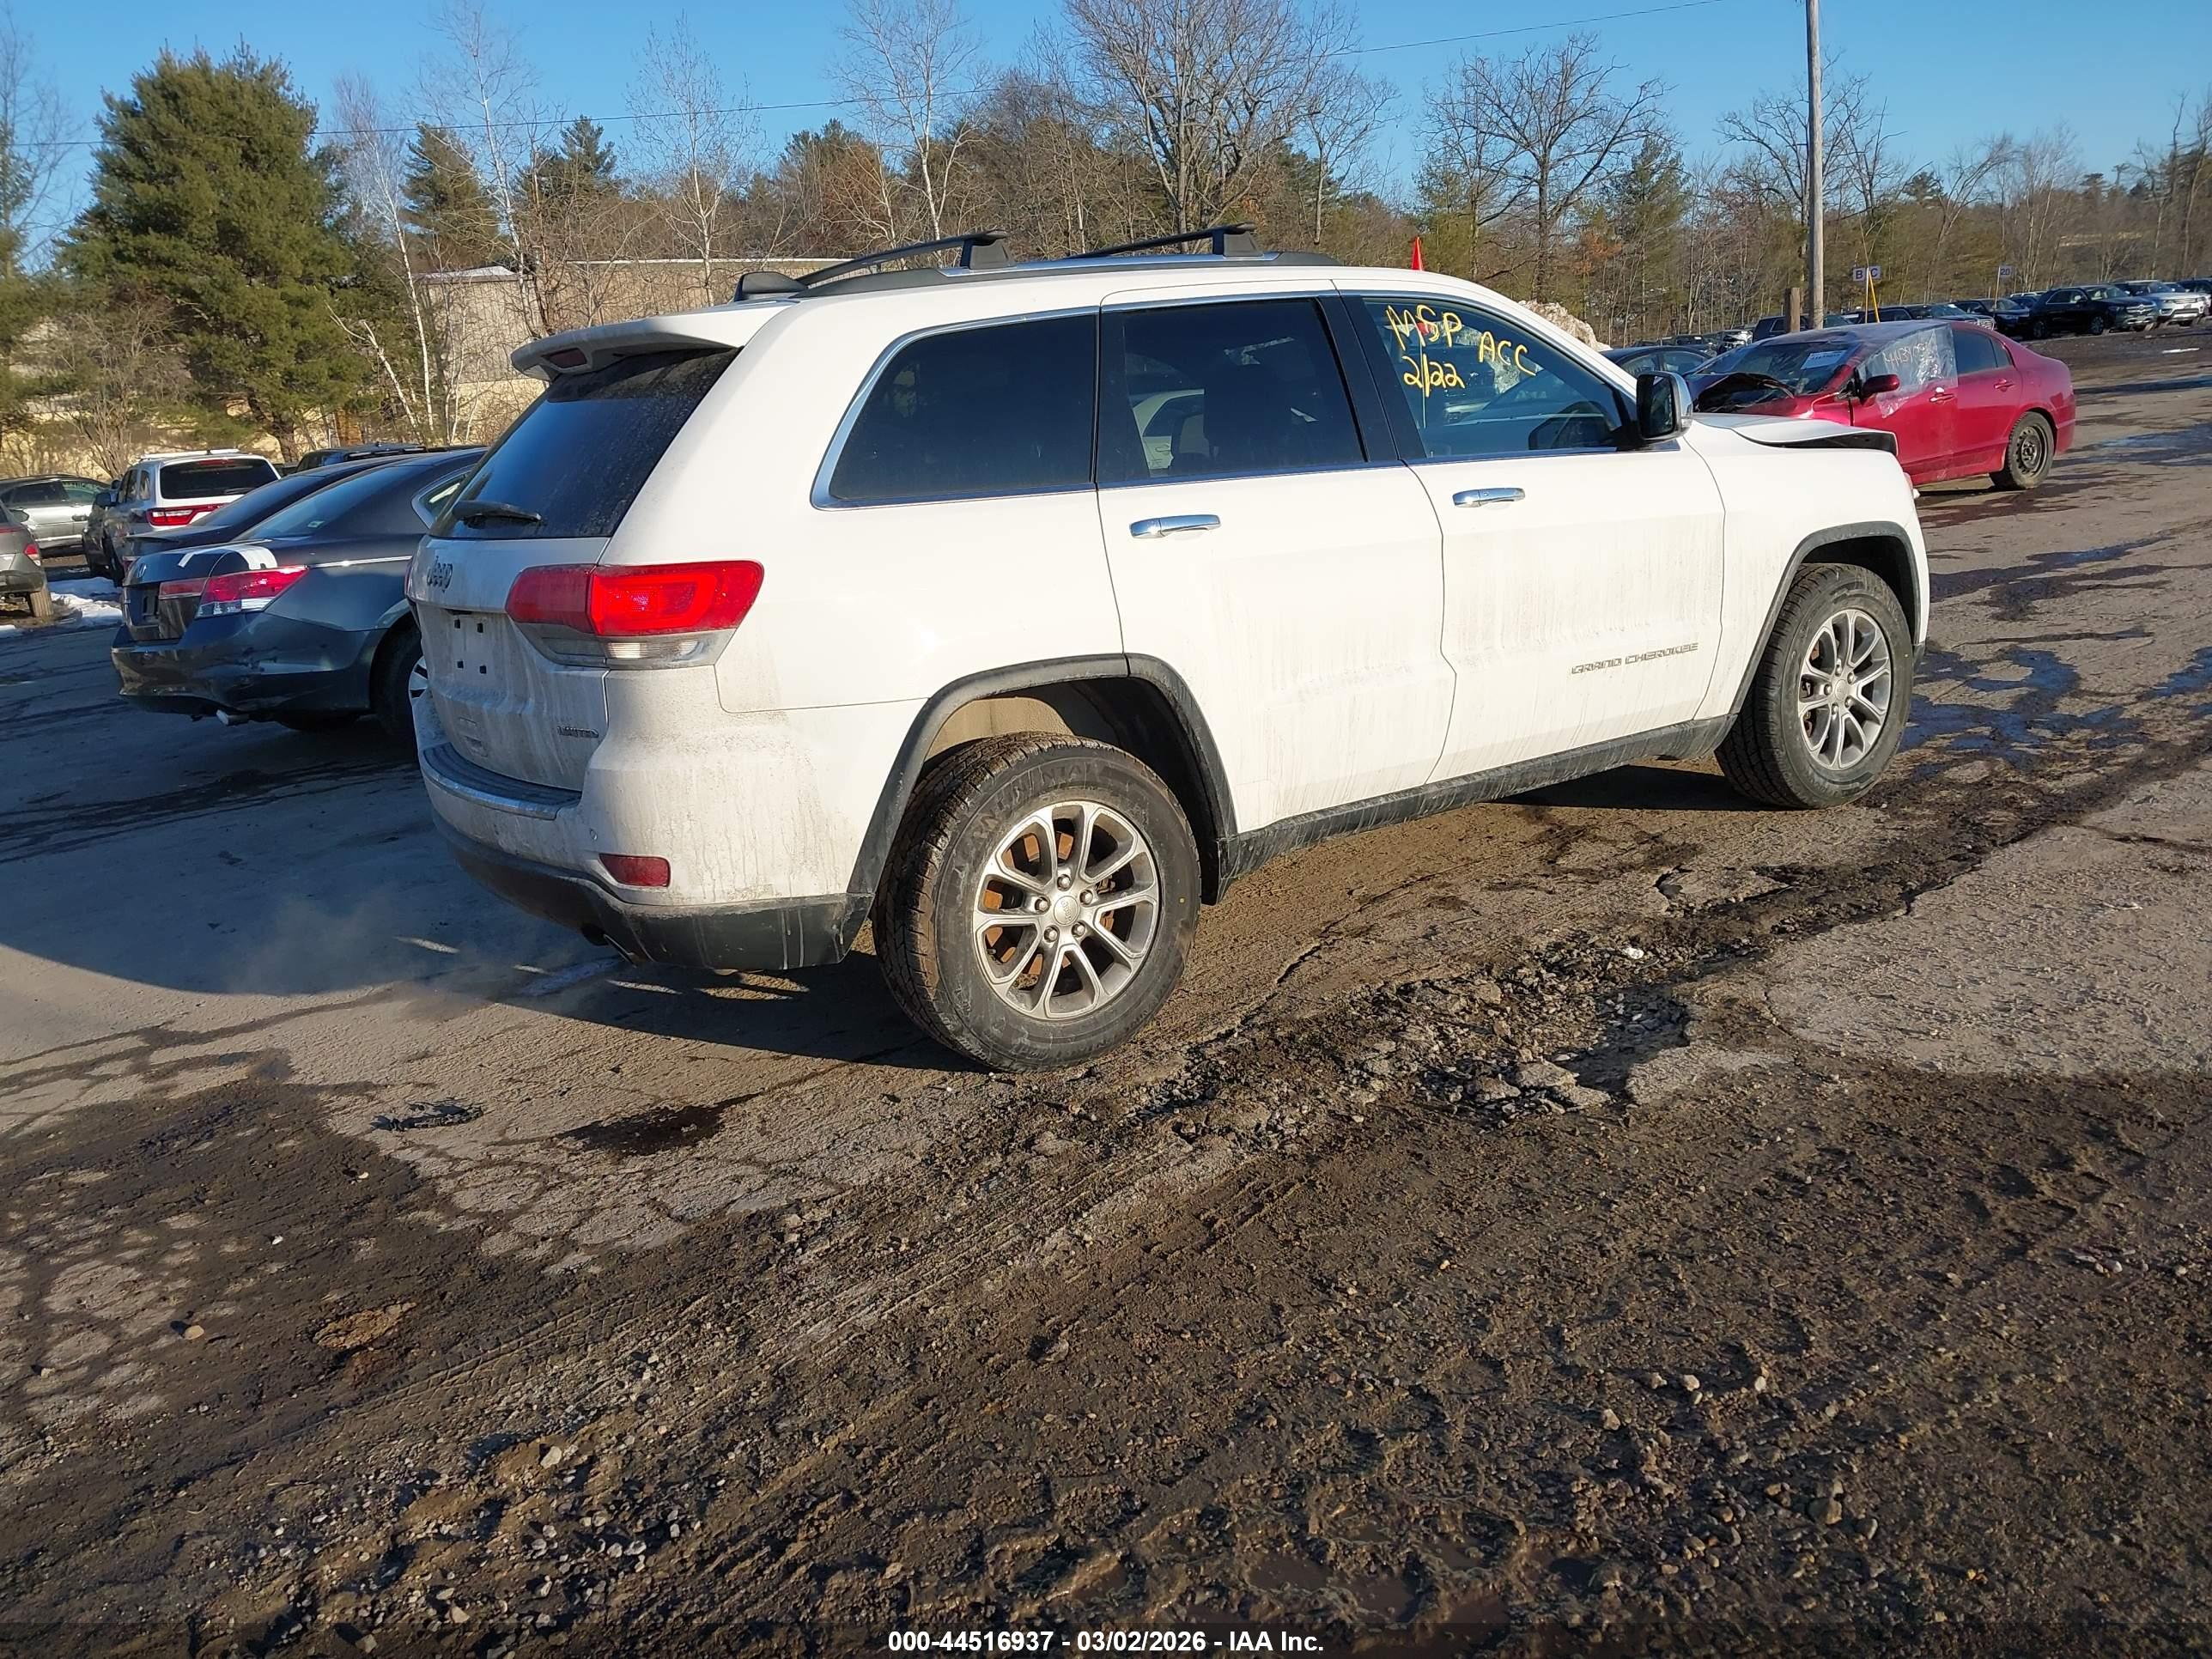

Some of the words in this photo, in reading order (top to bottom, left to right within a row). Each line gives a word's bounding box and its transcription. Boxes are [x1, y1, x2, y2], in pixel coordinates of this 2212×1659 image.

[1856, 270, 1863, 280] B
[1870, 267, 1879, 277] C
[1385, 304, 1463, 351] MSP
[1478, 331, 1536, 376] ACC
[1401, 353, 1466, 398] 2/22
[426, 556, 453, 593] Jeep
[1571, 658, 1622, 674] GRAND
[1625, 642, 1699, 665] CHEROKEE
